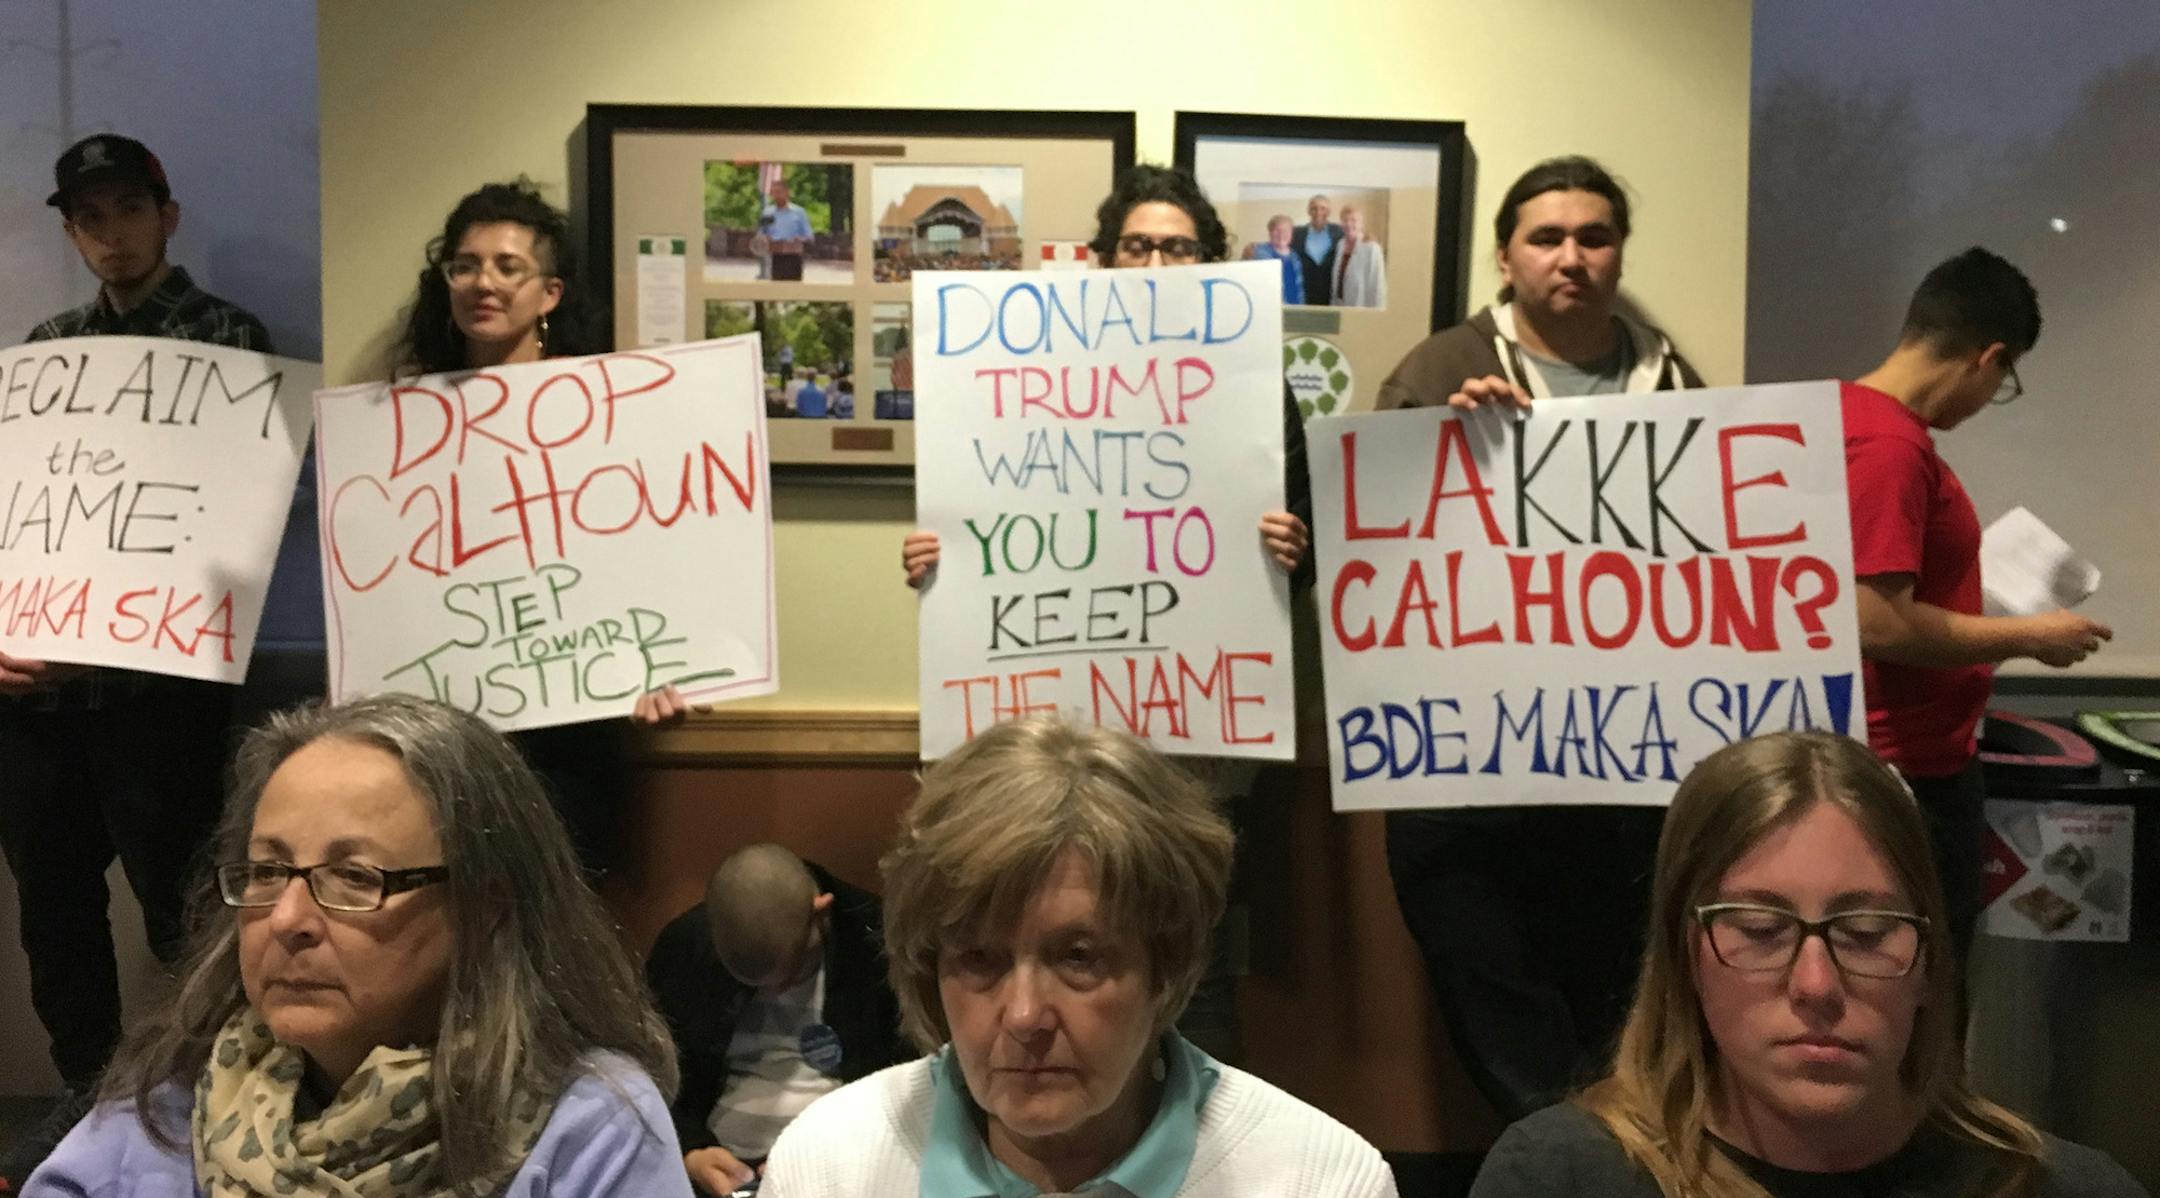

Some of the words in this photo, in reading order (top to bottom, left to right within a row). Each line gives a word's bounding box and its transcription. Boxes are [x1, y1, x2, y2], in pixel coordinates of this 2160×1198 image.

[937, 278, 1253, 356] DONALD
[0, 350, 283, 439] ECLAIM
[389, 353, 676, 480] DROP
[974, 357, 1215, 425] TRUMP
[46, 438, 126, 477] the
[973, 427, 1191, 500] WANTS
[1340, 417, 1806, 558] LAKKKE
[963, 508, 1098, 577] YOU
[1123, 506, 1216, 577] TO
[108, 586, 236, 663] SKA
[444, 564, 582, 648] STEP
[491, 608, 687, 661] TOWARD
[988, 580, 1180, 652] KEEP
[1331, 549, 1840, 653] CALHOUN?
[383, 641, 735, 718] JUSTICE
[943, 668, 1061, 742] THE
[1089, 644, 1275, 744] NAME
[1337, 698, 1468, 784] BDE
[1478, 681, 1682, 784] MAKA
